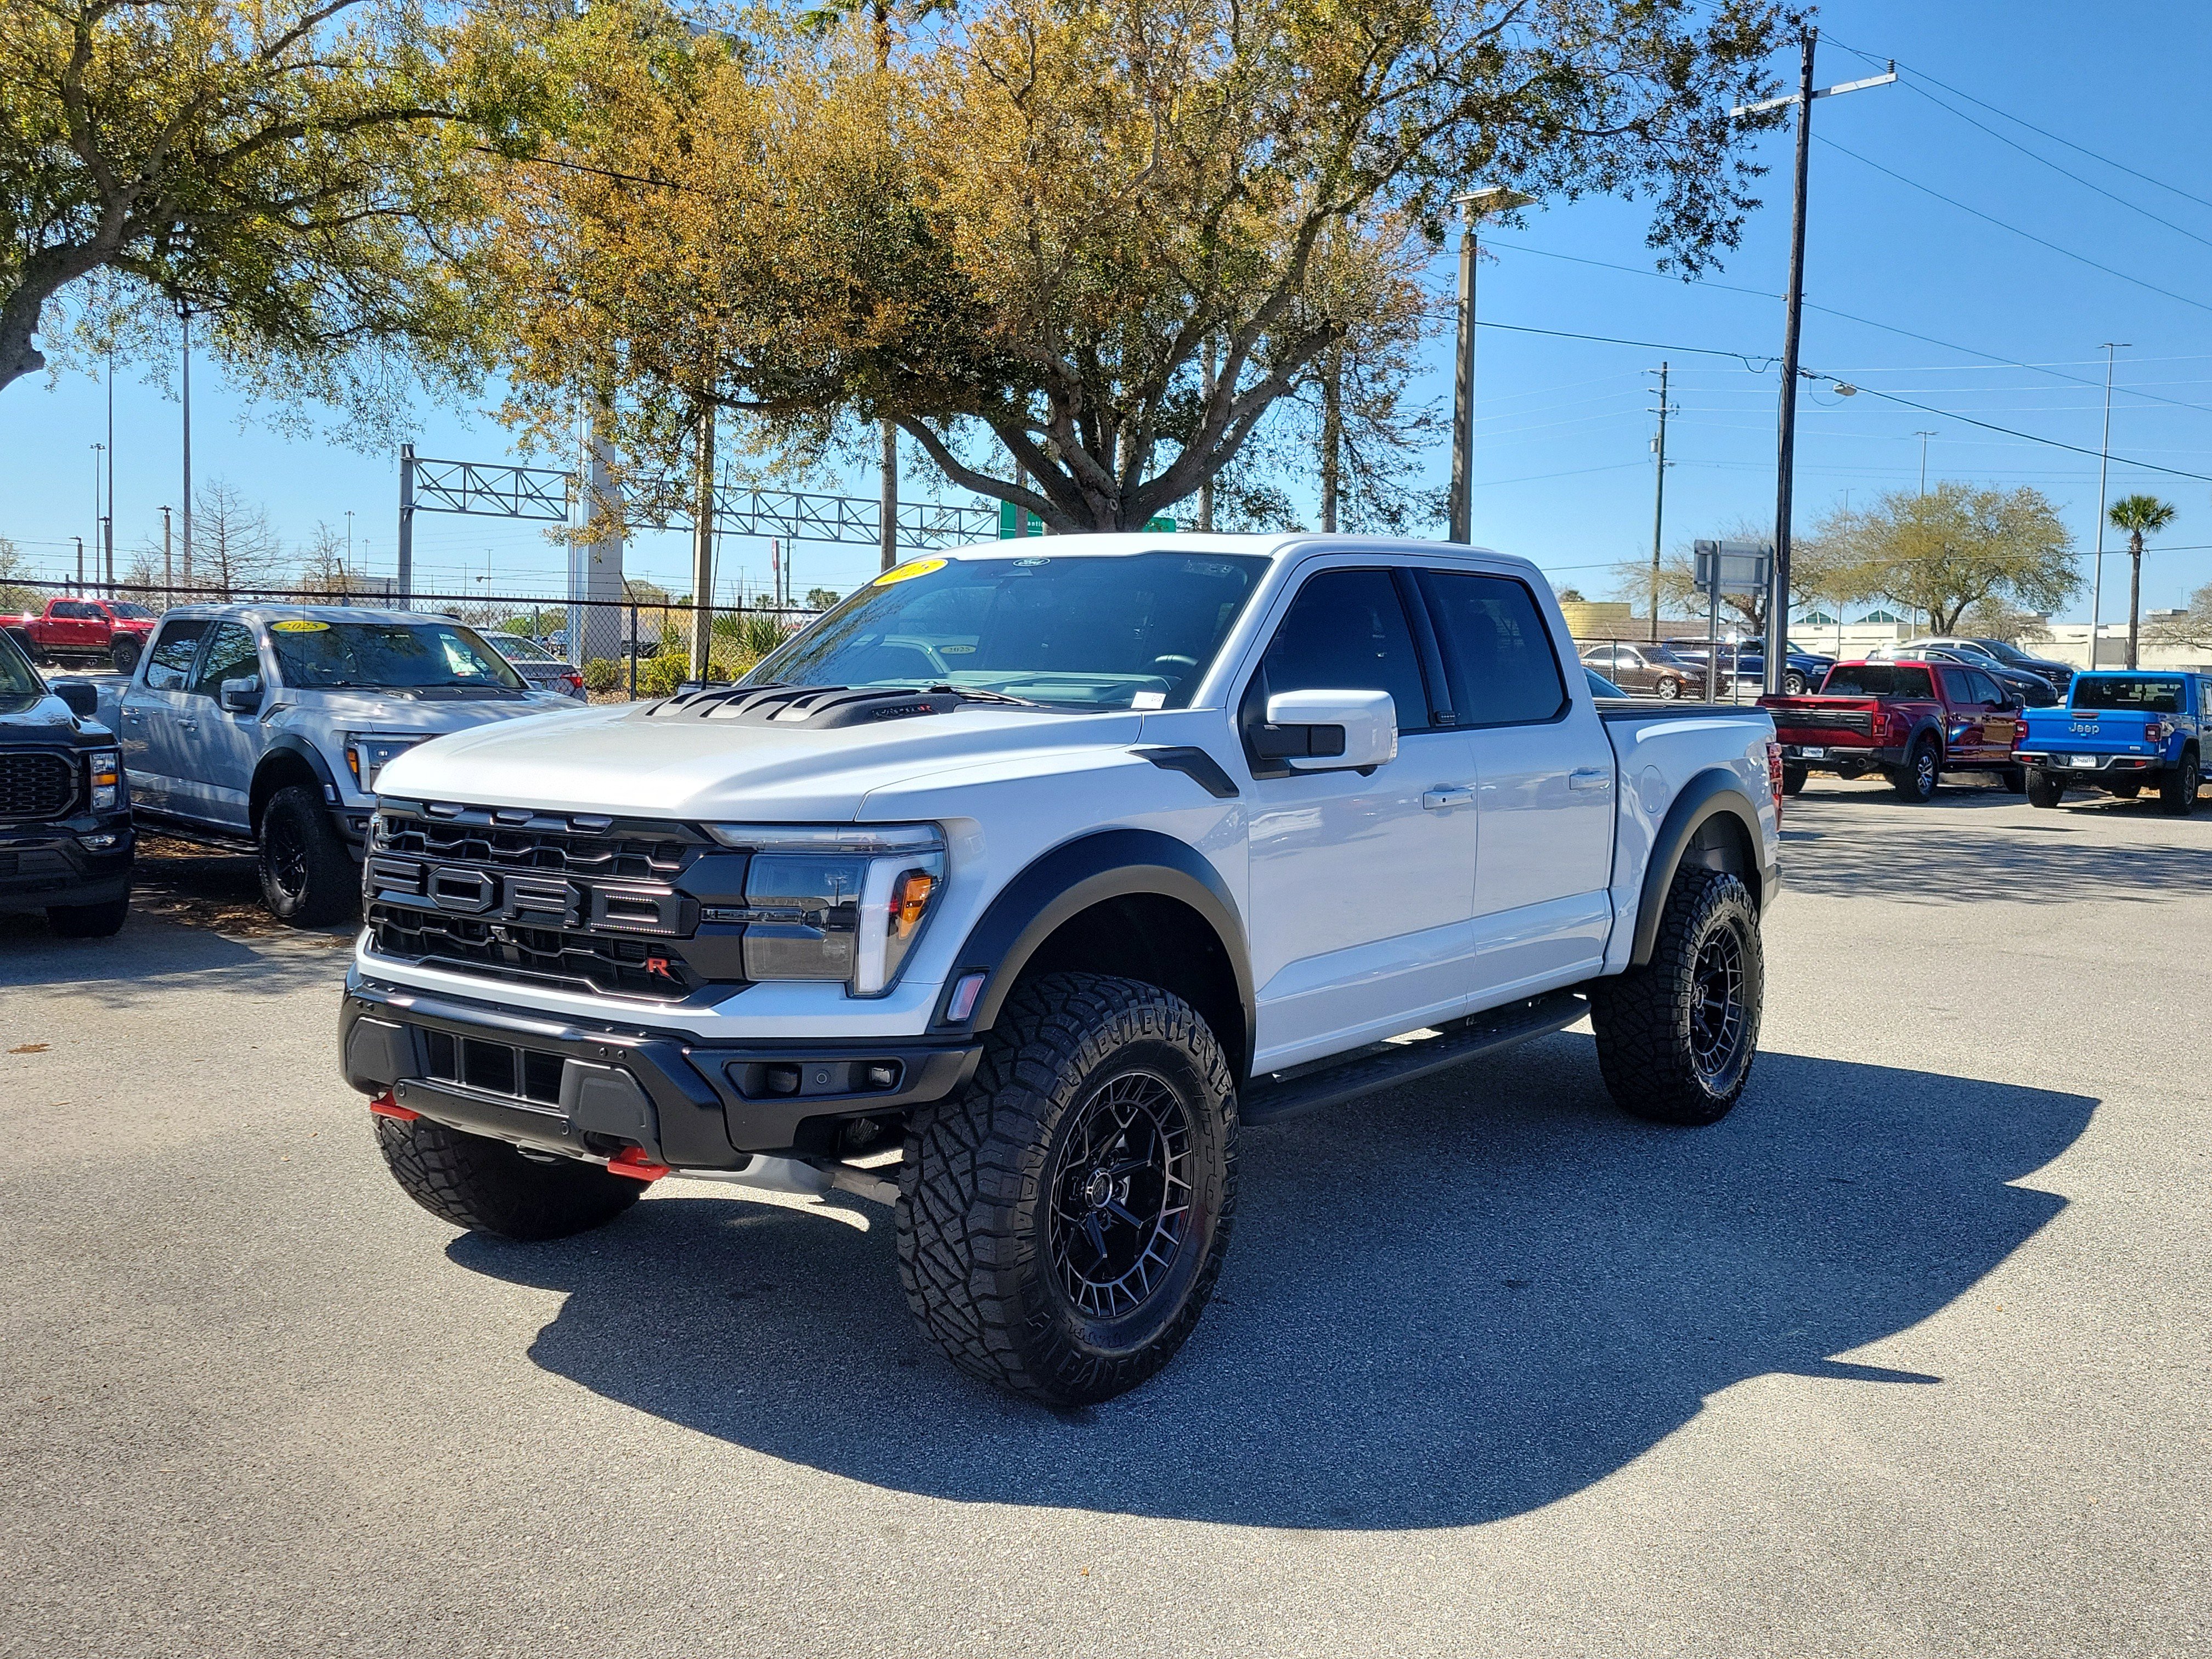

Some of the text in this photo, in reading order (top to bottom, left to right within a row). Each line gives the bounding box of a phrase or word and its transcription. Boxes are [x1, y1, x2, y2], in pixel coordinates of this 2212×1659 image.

[2068, 722, 2100, 735] Jeep
[365, 857, 682, 934] FORD
[647, 957, 670, 977] R
